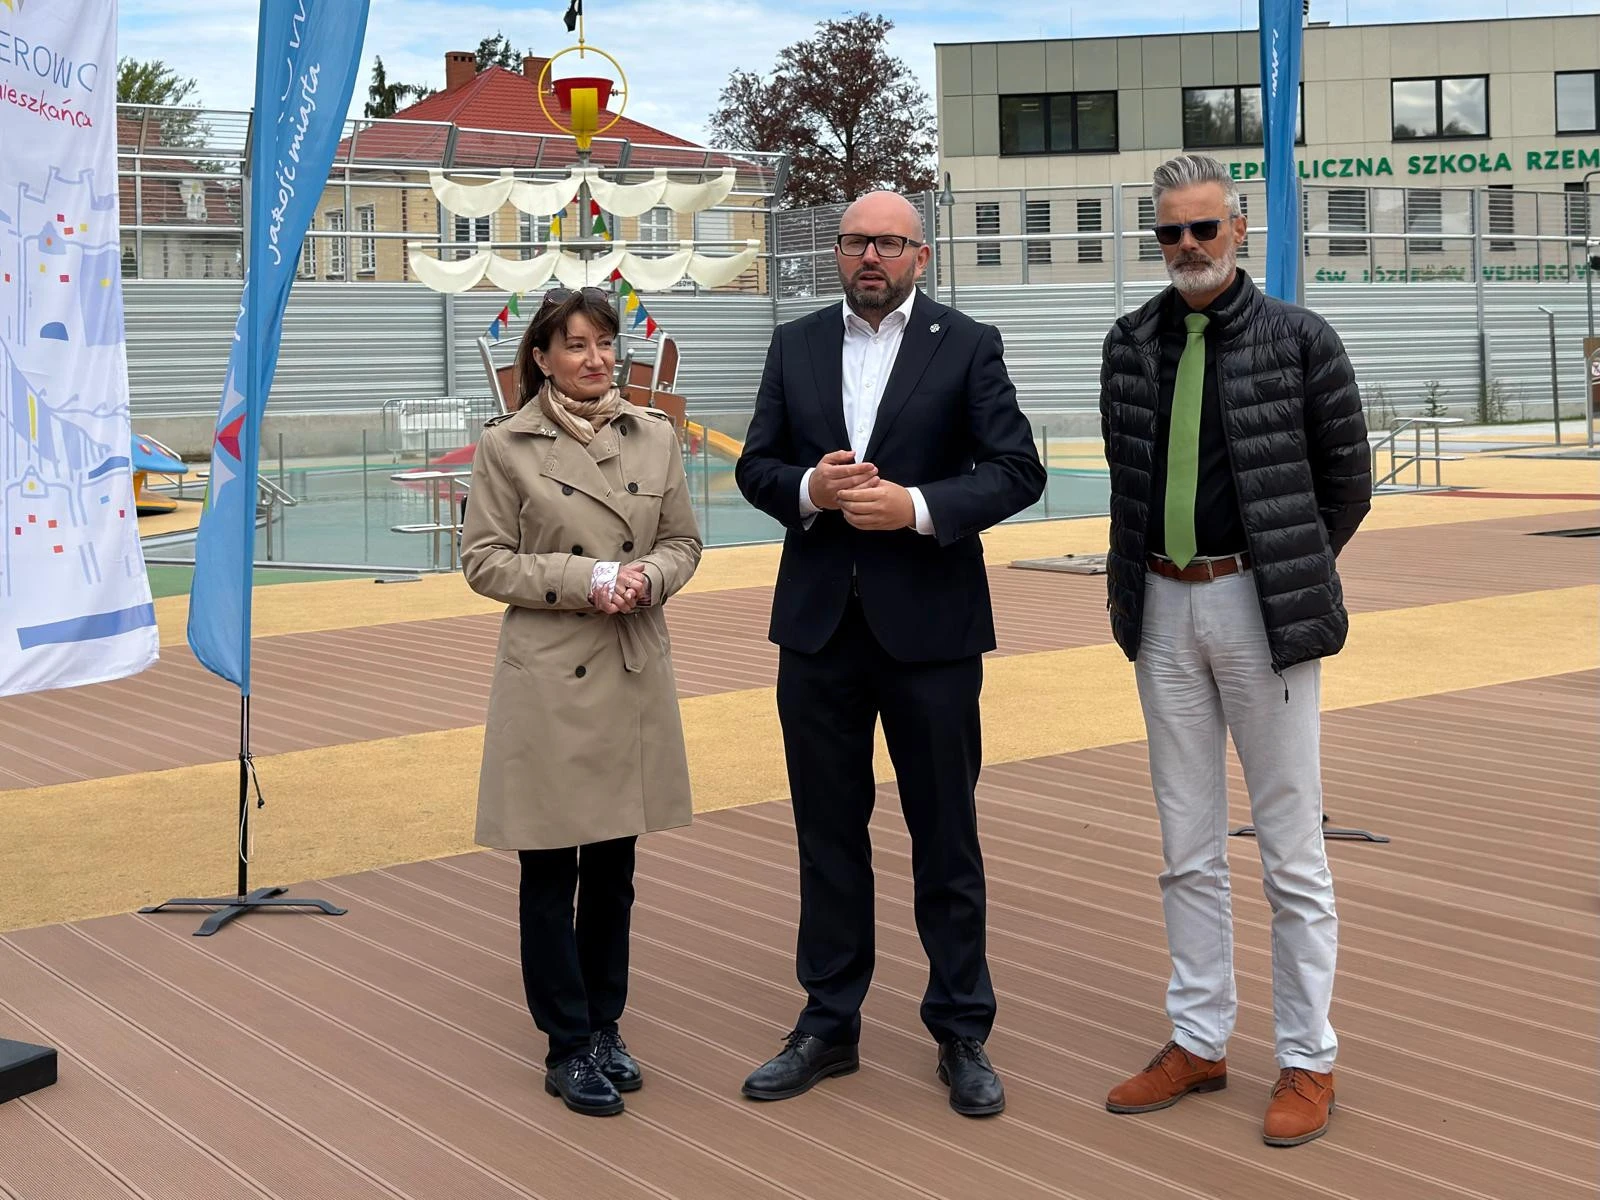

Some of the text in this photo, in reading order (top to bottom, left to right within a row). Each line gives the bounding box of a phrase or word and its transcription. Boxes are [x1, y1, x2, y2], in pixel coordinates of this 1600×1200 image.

[0, 79, 93, 128] ieszkańca
[288, 63, 320, 163] miasta
[1223, 148, 1600, 179] EPLICZNA SZKOŁA RZEM
